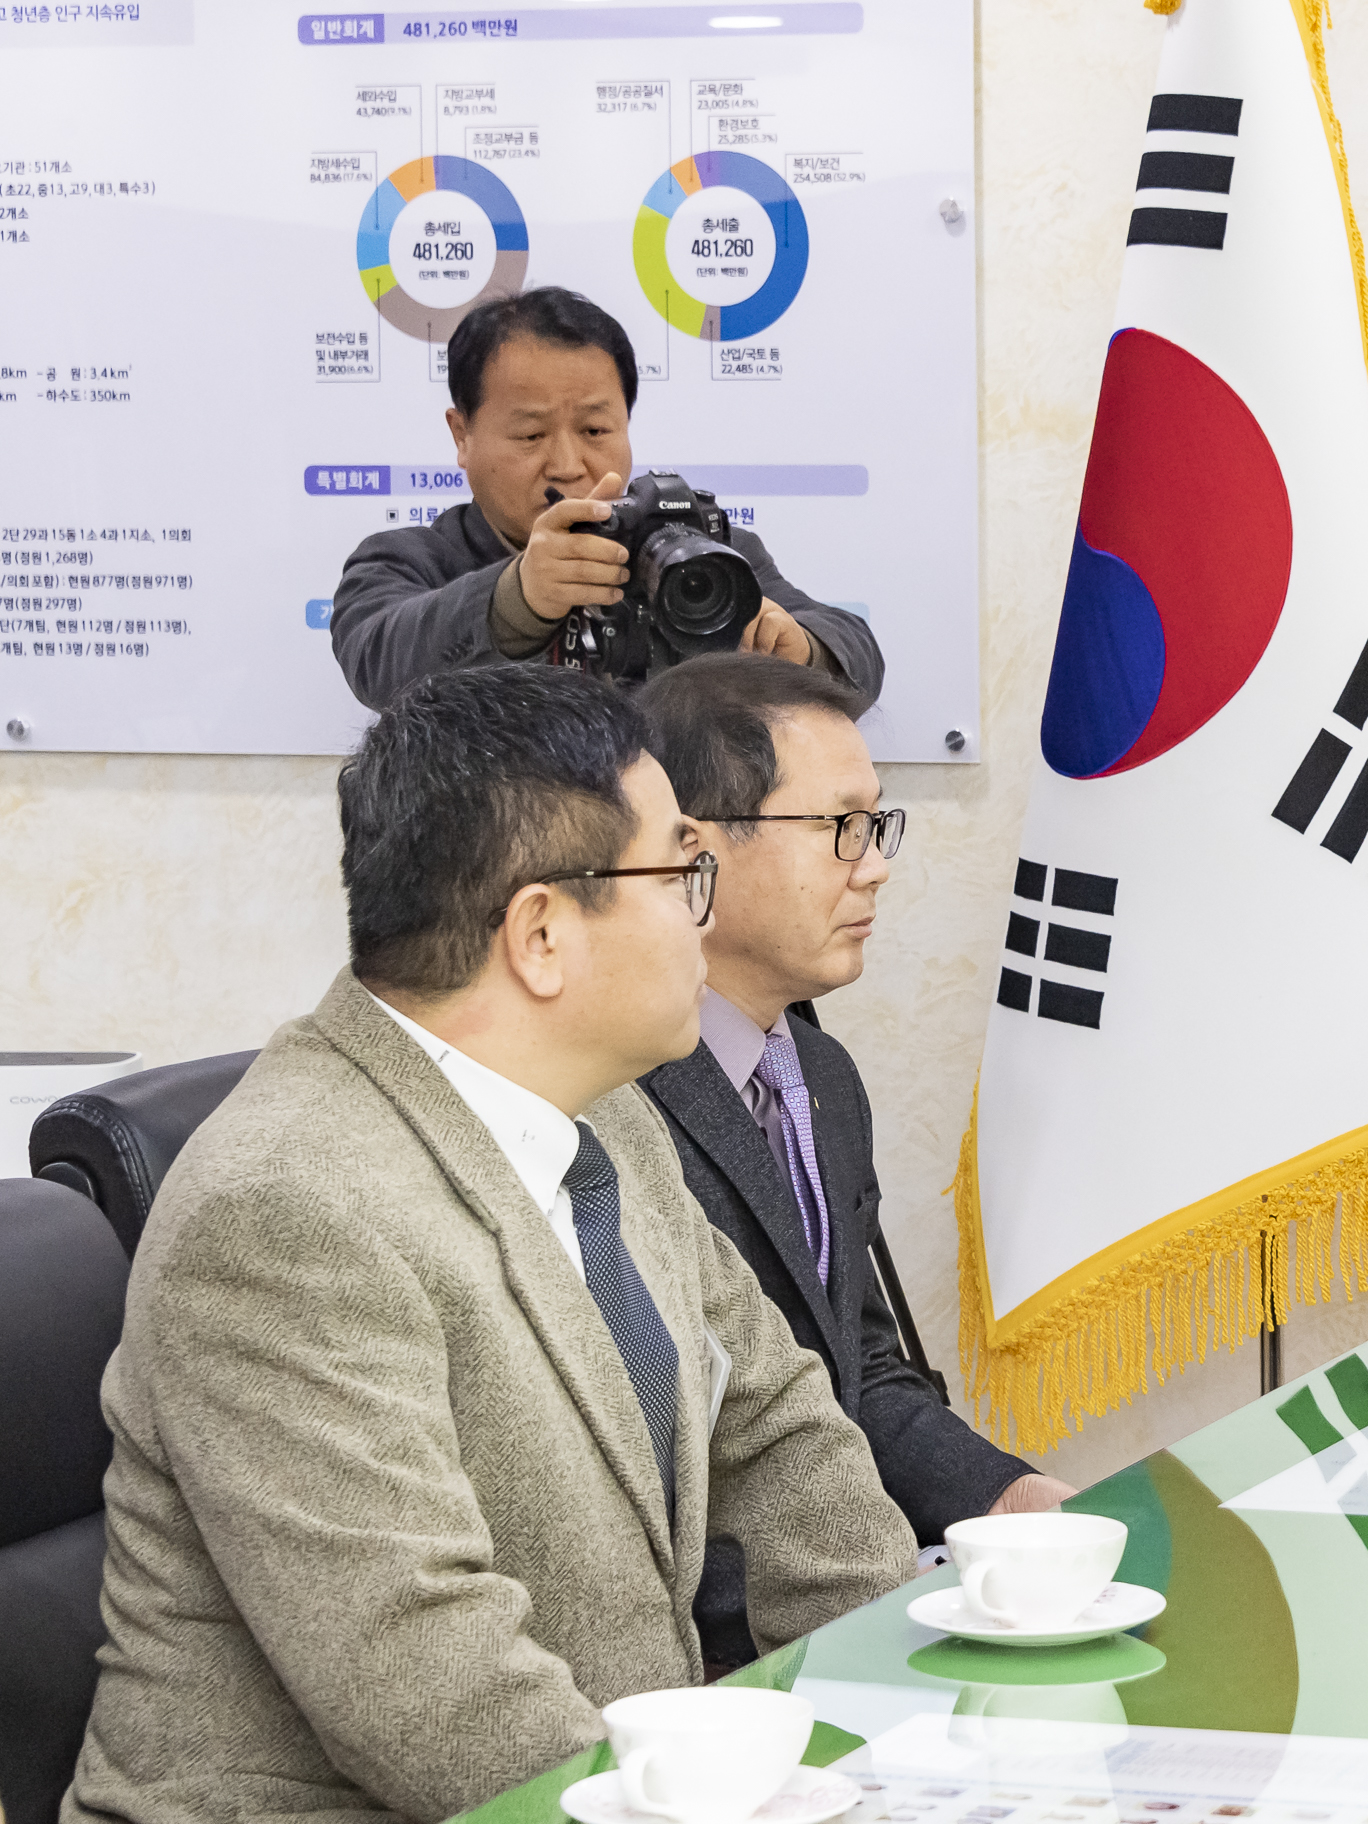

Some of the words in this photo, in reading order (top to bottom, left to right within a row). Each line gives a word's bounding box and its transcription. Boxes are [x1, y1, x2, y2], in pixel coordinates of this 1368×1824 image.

[11, 5, 51, 24] 청년층
[55, 5, 82, 22] 인구
[86, 3, 140, 22] 지속유입
[311, 19, 375, 40] 일반회계
[403, 22, 468, 39] 481,260
[472, 18, 518, 37] 백만원
[718, 118, 761, 132] 환경보호
[425, 221, 461, 237] 총세입
[702, 218, 740, 234] 총세출
[413, 242, 474, 261] 481,260
[691, 238, 754, 258] 481,260
[720, 348, 766, 362] 산업/국토
[770, 348, 780, 361] 등
[316, 470, 380, 491] 특별회계
[658, 500, 691, 510] Canon
